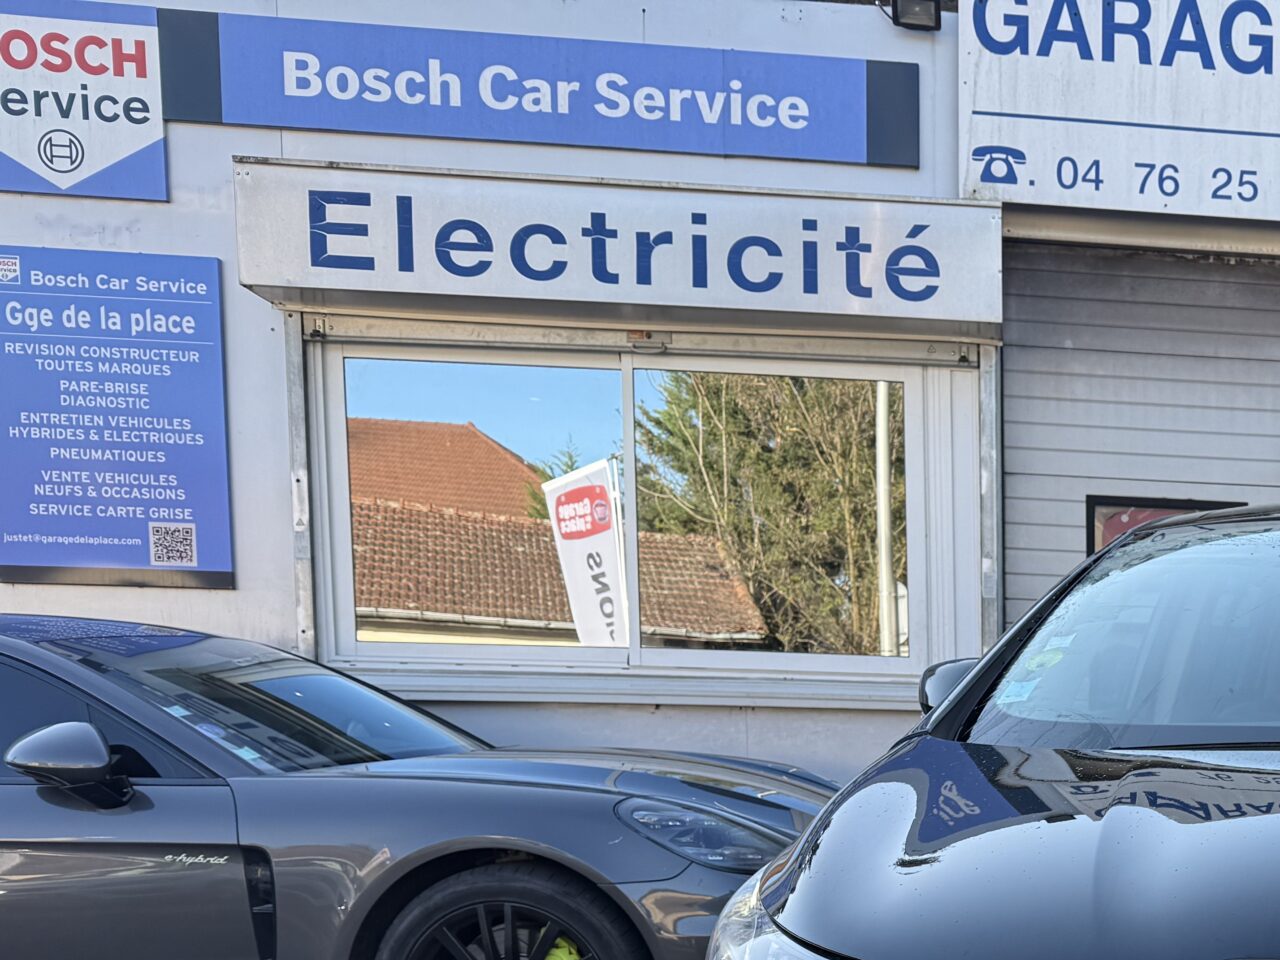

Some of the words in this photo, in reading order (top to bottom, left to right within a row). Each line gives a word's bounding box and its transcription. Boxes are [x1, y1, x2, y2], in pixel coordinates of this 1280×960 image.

[283, 51, 462, 107] Bosch
[478, 64, 580, 114] Car
[593, 72, 809, 130] Service
[1055, 157, 1104, 191] 04
[1134, 162, 1180, 197] 76
[1211, 168, 1259, 202] 25
[308, 189, 941, 302] Electricité
[30, 270, 89, 288] Bosch
[96, 274, 129, 290] Car
[136, 276, 207, 294] Service
[5, 301, 53, 332] Gge
[62, 304, 91, 328] de
[100, 305, 121, 330] la
[130, 308, 195, 336] place
[5, 342, 76, 357] REVISION
[80, 346, 200, 363] CONSTRUCTEUR
[35, 359, 94, 372] TOUTES
[98, 362, 171, 376] MARQUES
[60, 380, 149, 395] PARE-BRISE
[60, 395, 150, 409] DIAGNOSTIC
[20, 412, 104, 426] ENTRETIEN
[108, 415, 191, 430] VEHICULES
[9, 426, 85, 440] HYBRIDES
[89, 429, 99, 441] &
[104, 430, 204, 445] ELECTRIQUES
[50, 447, 166, 463] PNEUMATIQUES
[41, 470, 90, 483] VENTE
[95, 472, 178, 486] VEHICULES
[34, 484, 83, 497] NEUFS
[87, 486, 97, 497] &
[101, 487, 186, 500] OCCASIONS
[29, 503, 92, 516] SERVICE
[97, 506, 145, 518] CARTE
[150, 508, 193, 520] GRISE
[3, 533, 142, 546] justet@garagedelaplace.com
[164, 853, 229, 867] e-hybrid
